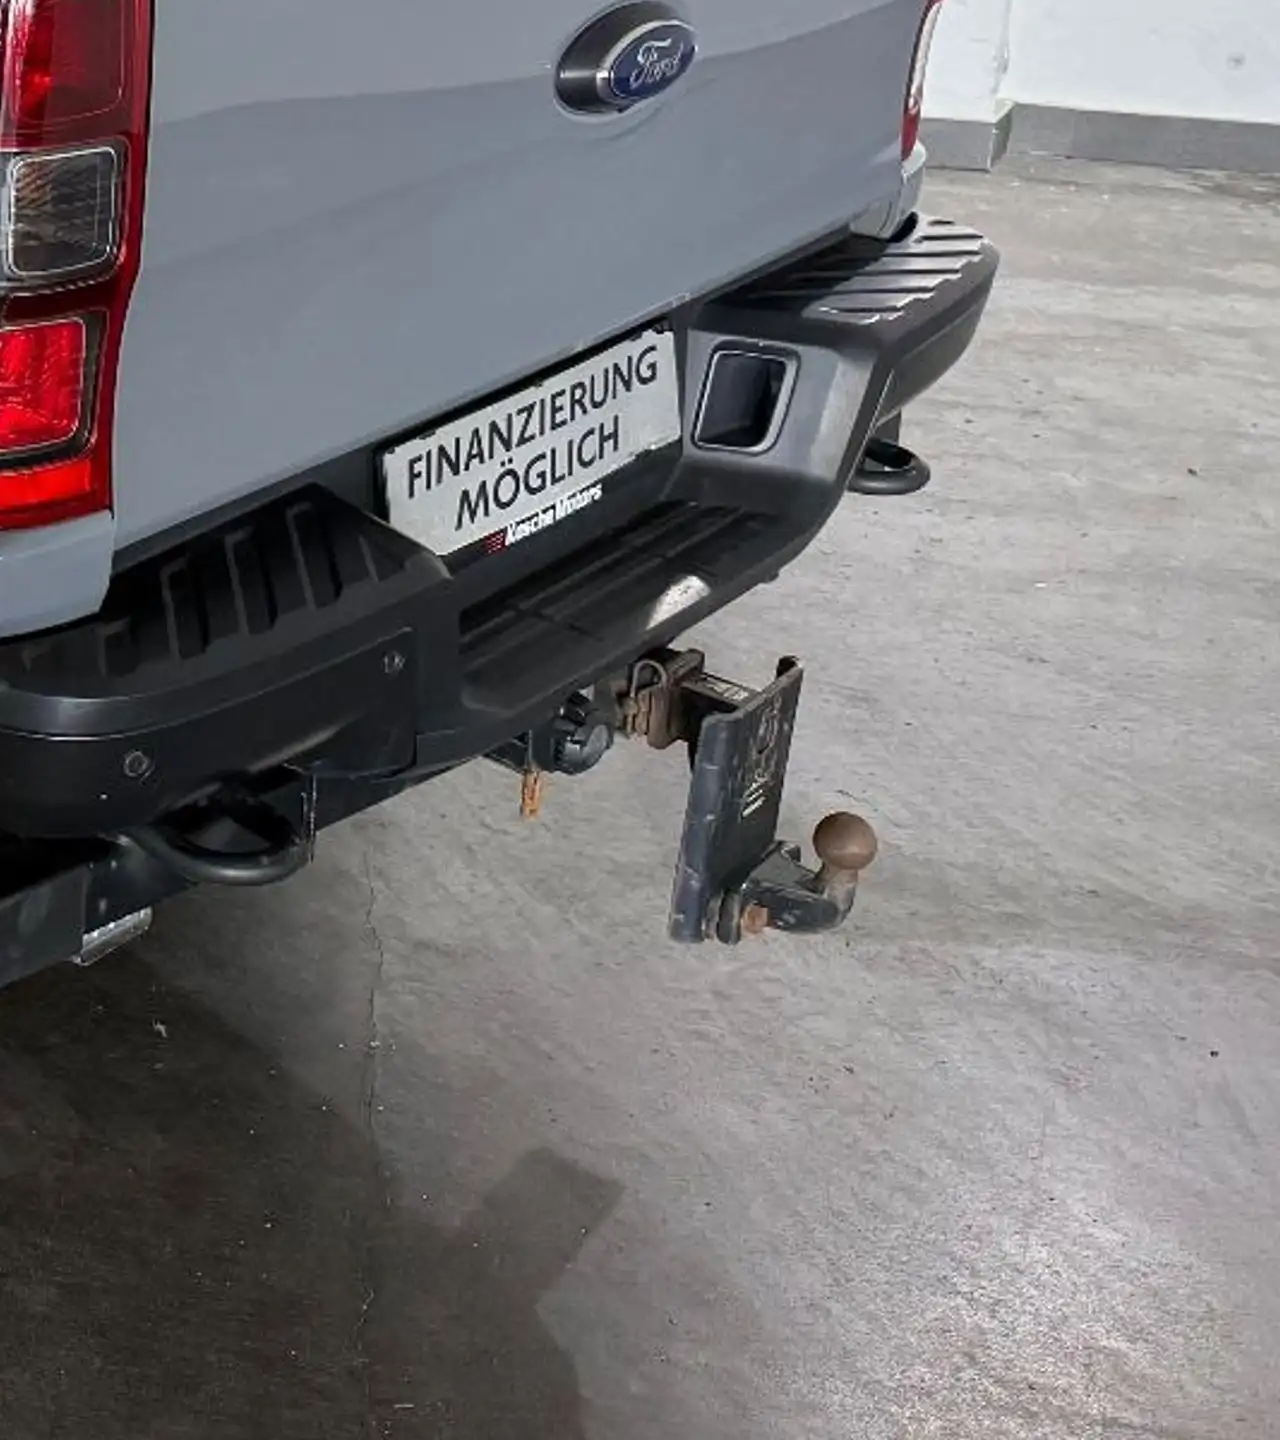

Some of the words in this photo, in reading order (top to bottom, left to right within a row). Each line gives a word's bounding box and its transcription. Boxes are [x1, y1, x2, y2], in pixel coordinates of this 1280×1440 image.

[628, 37, 684, 90] Ford
[407, 345, 658, 500] FINANZIERUNG
[454, 414, 620, 533] MÖGLICH
